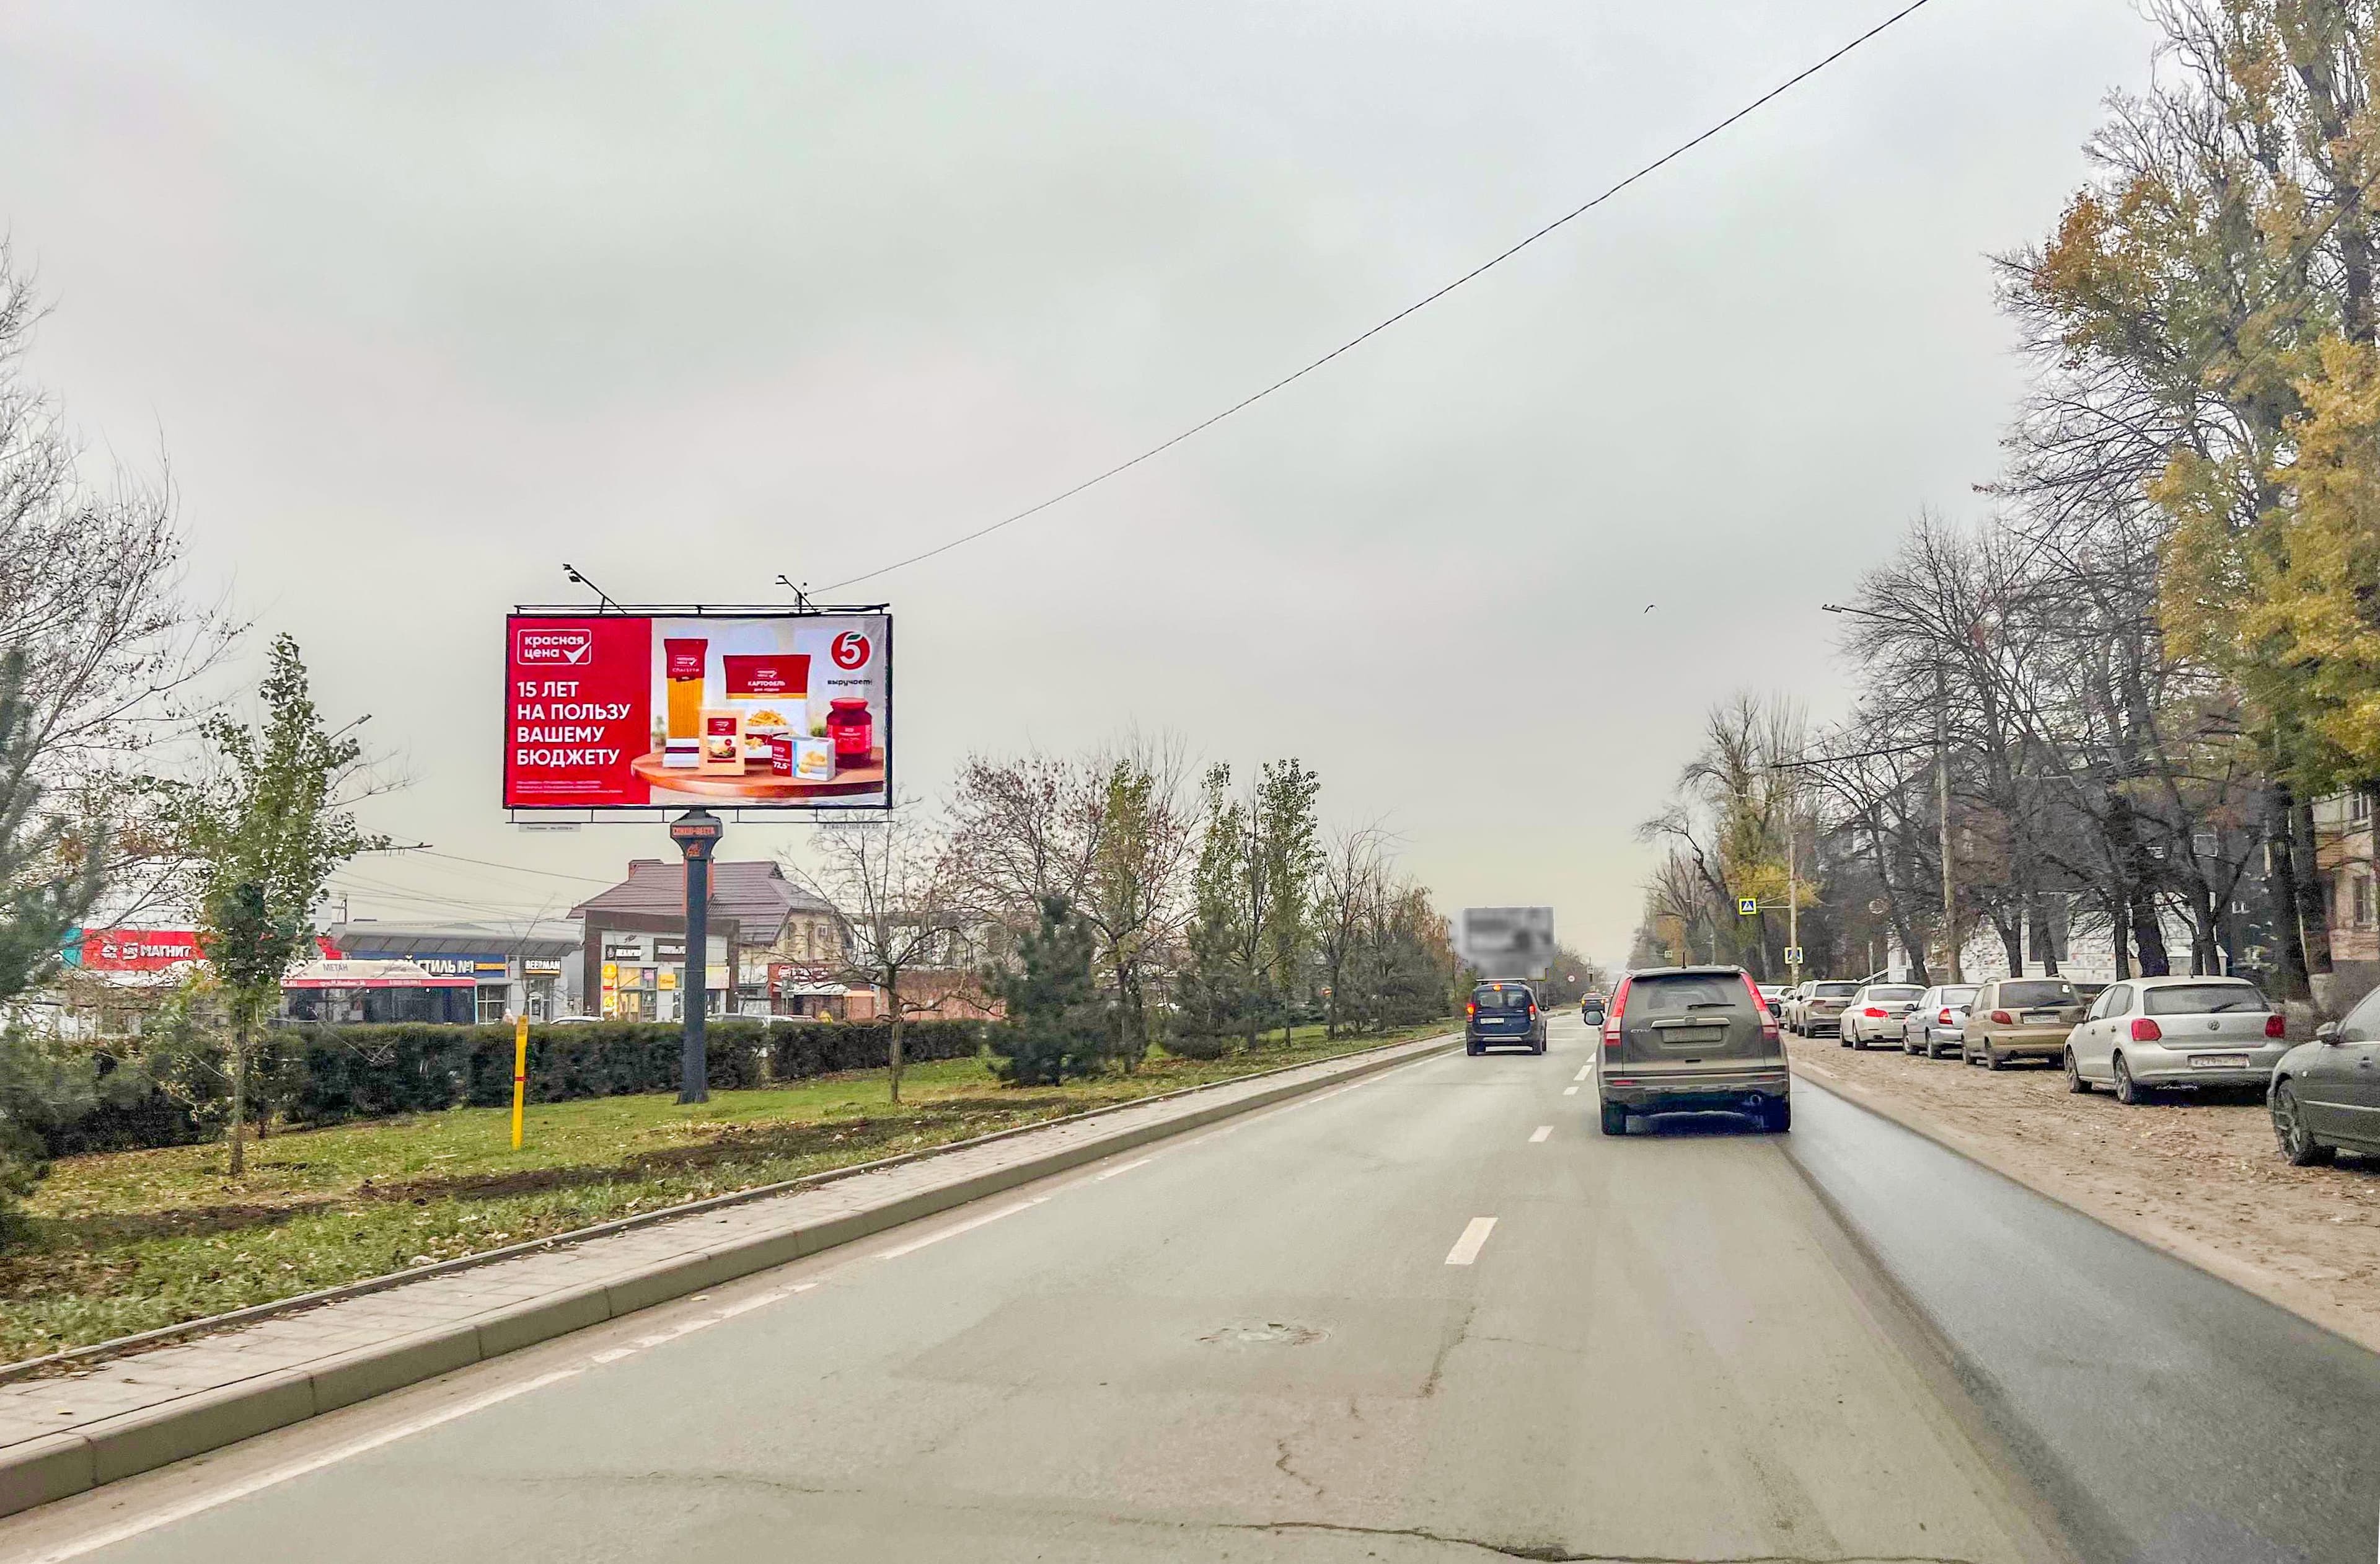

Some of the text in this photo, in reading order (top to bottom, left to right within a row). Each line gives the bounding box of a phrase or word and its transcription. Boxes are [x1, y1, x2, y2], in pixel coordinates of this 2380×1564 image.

[524, 636, 584, 648] красная
[524, 648, 560, 659] цена
[517, 681, 580, 697] 15 ЛЕТ
[517, 704, 632, 720] НА ПОЛЬЗУ
[517, 727, 605, 743] ВАШЕМУ
[517, 749, 620, 768] БЮДЖЕТУ
[140, 945, 192, 958] МАГНИТ
[322, 963, 348, 972] МЕТАН
[415, 960, 456, 974] СТИЛЬ
[457, 960, 474, 973] №1
[526, 960, 560, 970] BEERMAN
